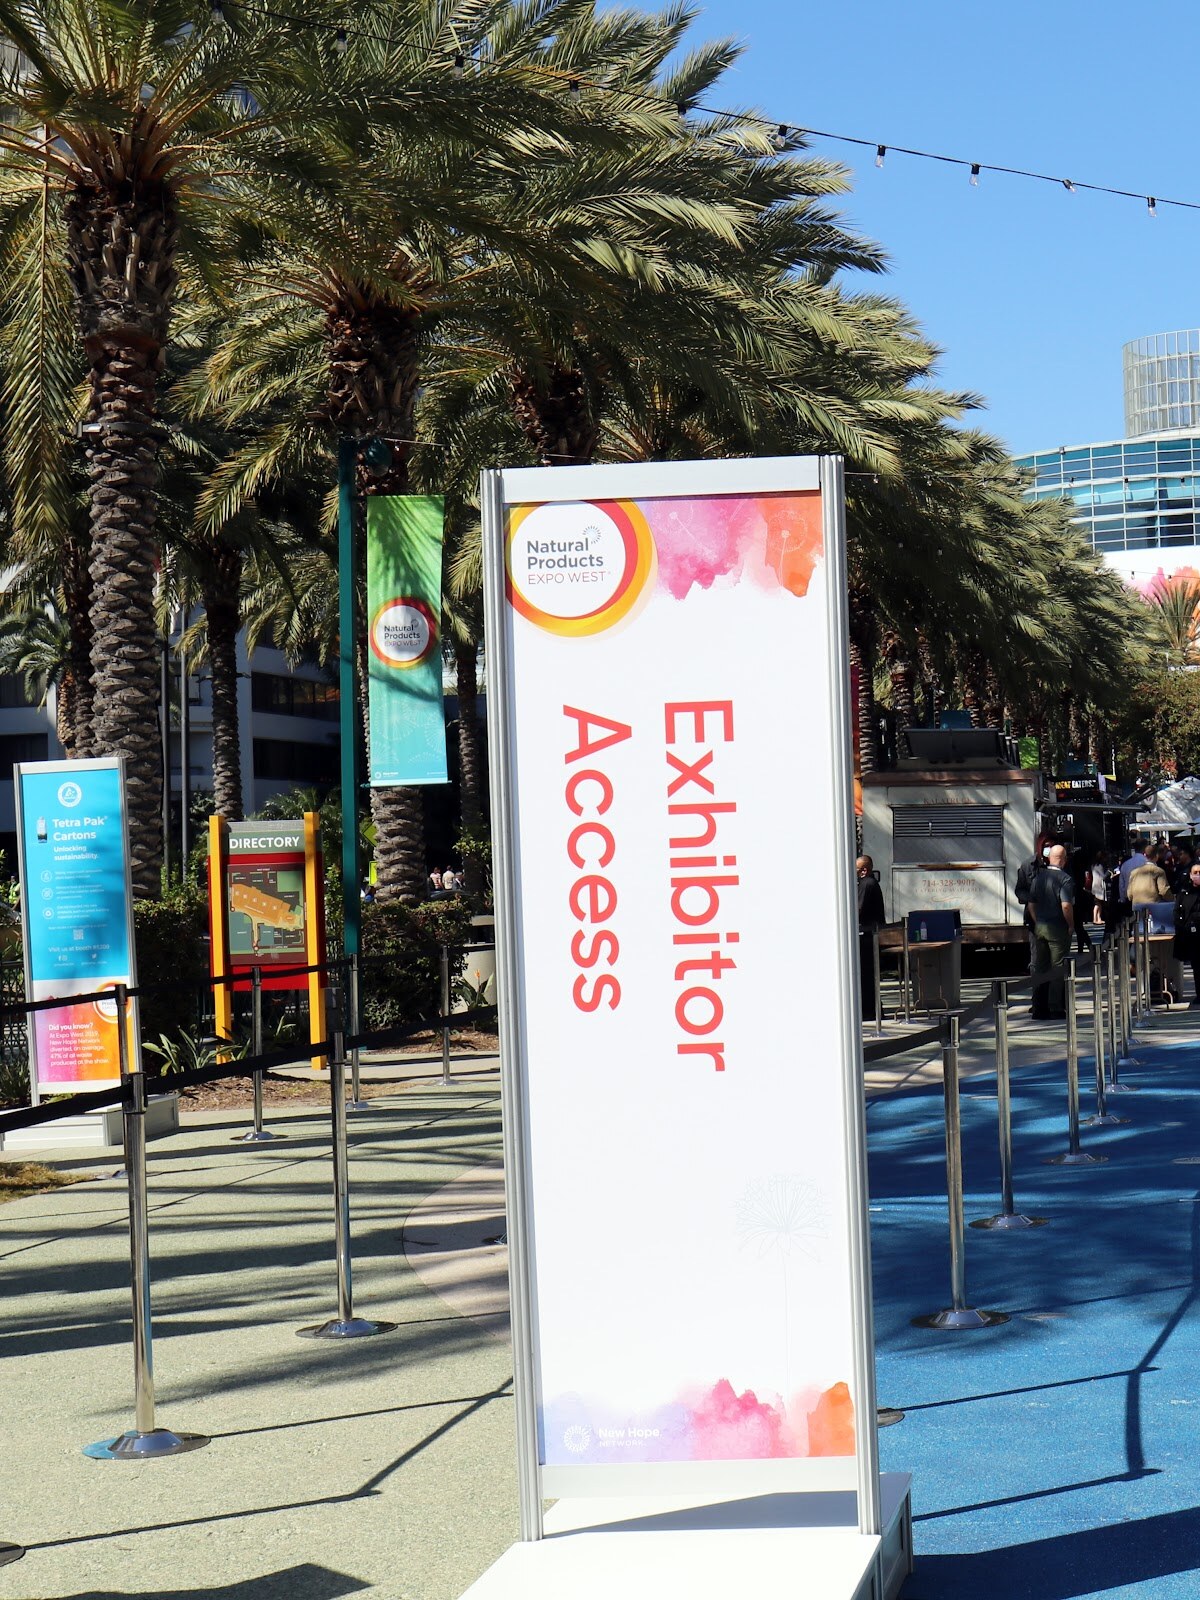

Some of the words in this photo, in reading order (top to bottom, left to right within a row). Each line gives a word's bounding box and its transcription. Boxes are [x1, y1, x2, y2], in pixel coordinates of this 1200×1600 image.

[527, 537, 589, 554] Natural
[527, 554, 604, 569] Products
[528, 573, 565, 585] EXPO
[568, 571, 607, 583] WEST
[384, 624, 414, 632] Natural
[384, 632, 421, 640] Products
[52, 818, 81, 828] Tetra
[53, 831, 97, 841] Cartons
[229, 836, 300, 849] DIRECTORY
[563, 705, 632, 1012] Access
[665, 700, 739, 1071] Exhibitor
[73, 1022, 94, 1030] know?
[599, 1427, 625, 1438] New
[628, 1427, 660, 1439] Hope
[599, 1439, 643, 1448] NETWORK
